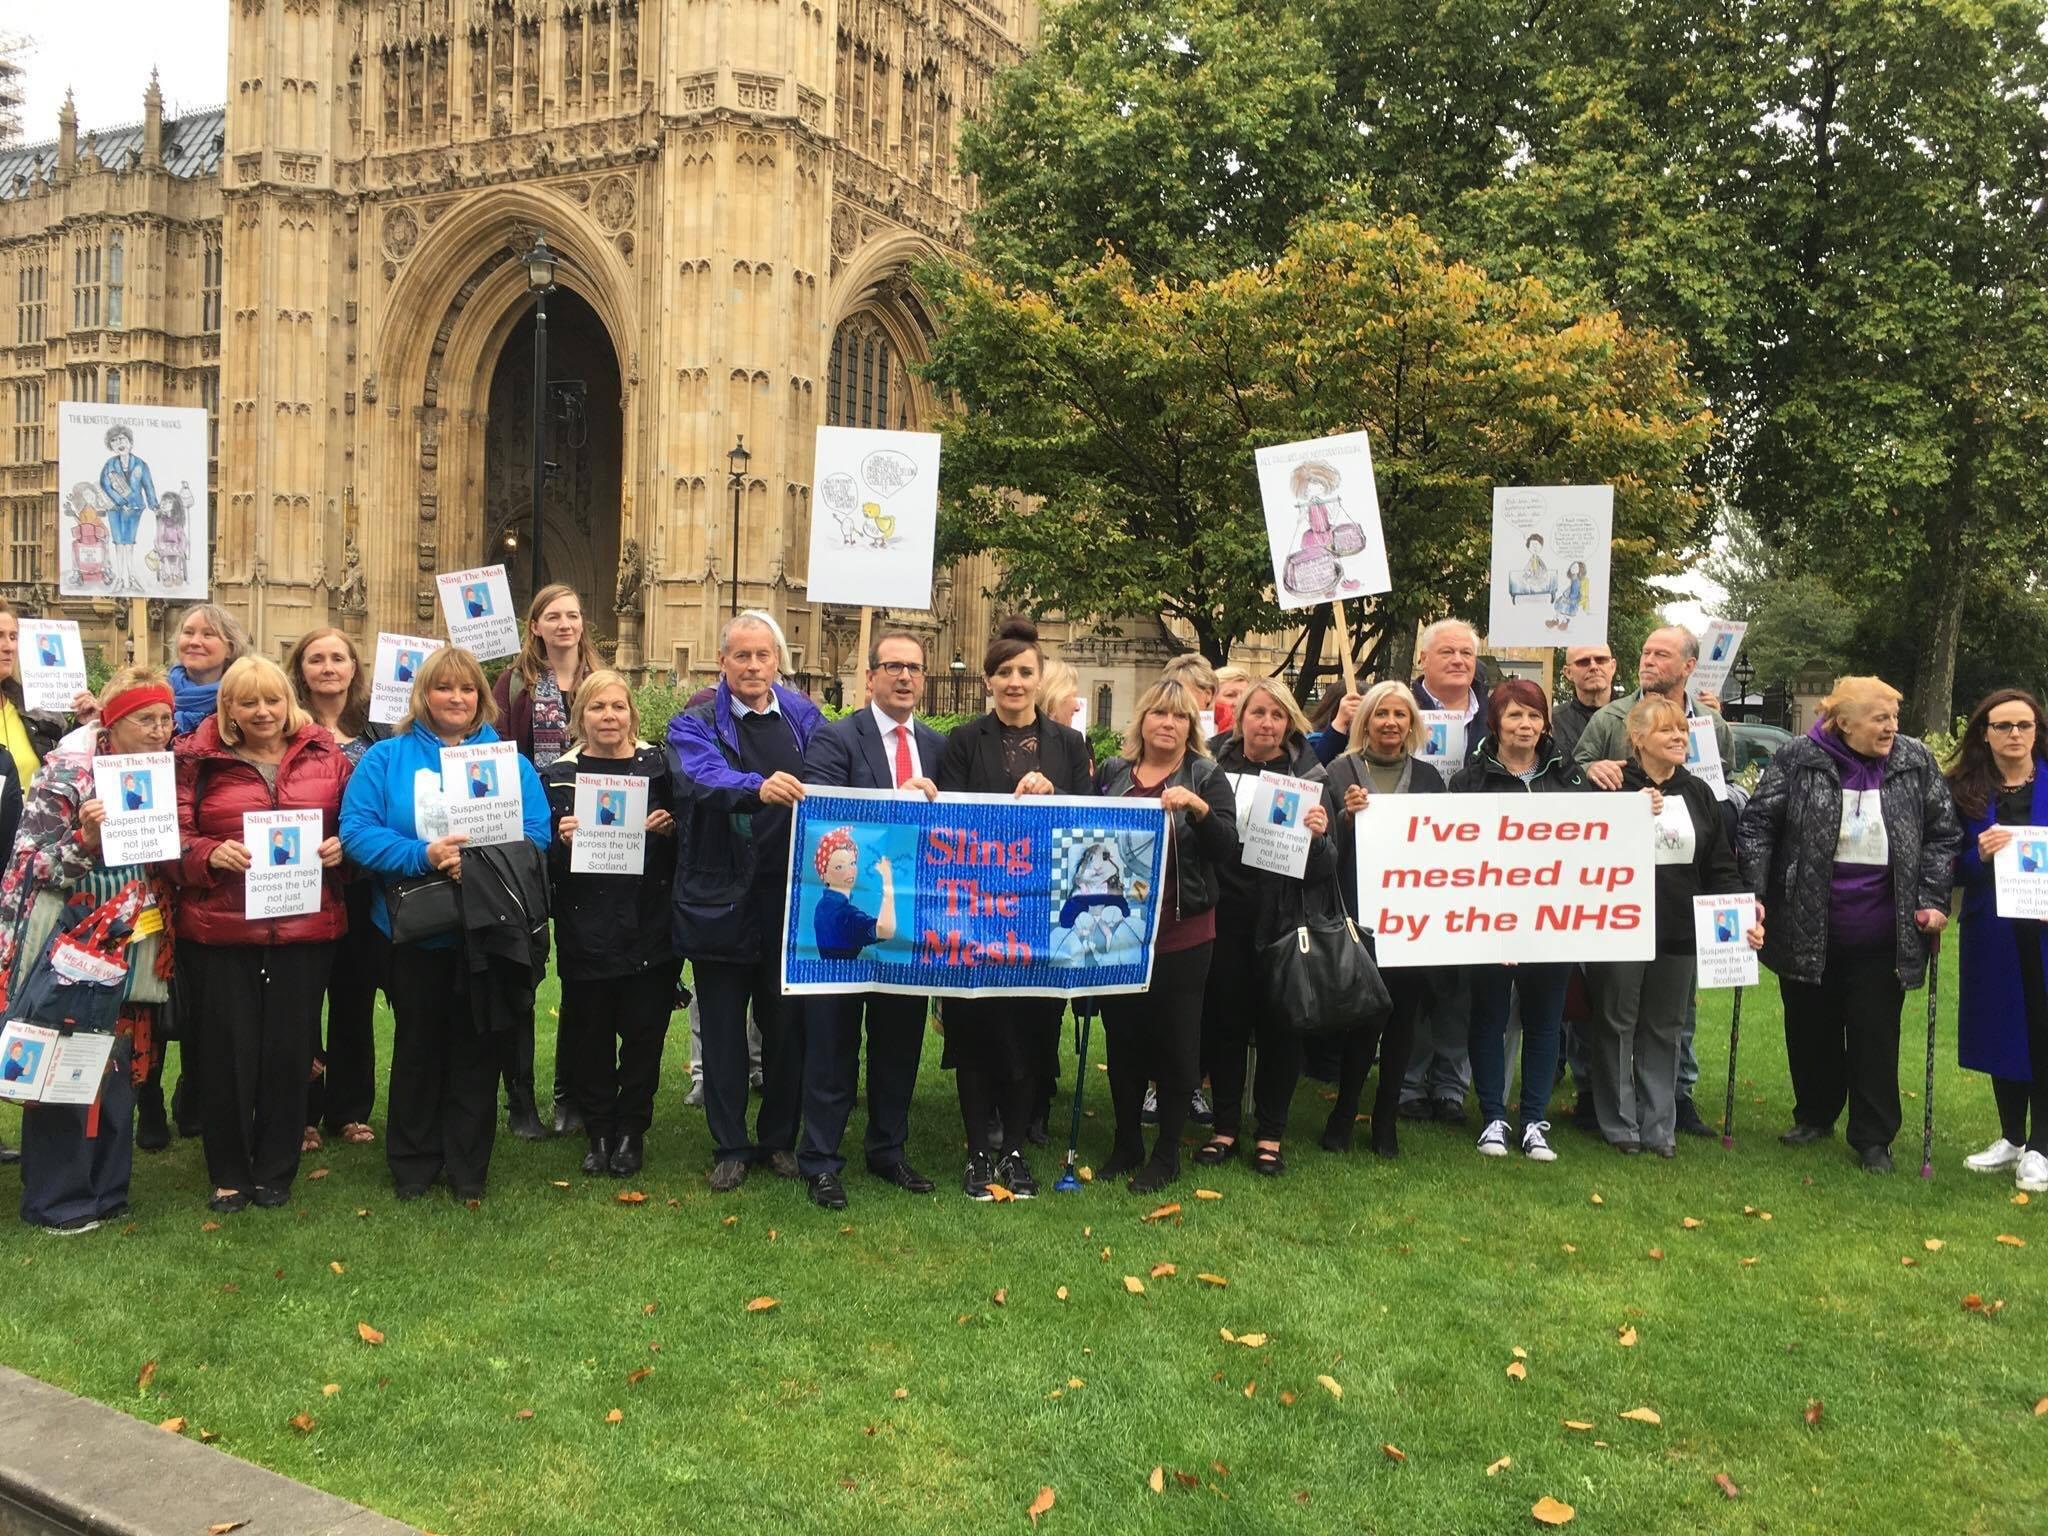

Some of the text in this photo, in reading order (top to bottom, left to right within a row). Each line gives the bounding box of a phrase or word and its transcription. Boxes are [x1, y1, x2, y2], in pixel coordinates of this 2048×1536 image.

[440, 568, 504, 585] Sling The Mesh
[451, 616, 514, 633] Suspend mesh
[455, 626, 513, 644] across the UK
[404, 639, 417, 647] The
[472, 639, 502, 651] not just
[474, 648, 506, 660] cotland
[24, 671, 84, 681] Suspend mesh
[56, 681, 68, 689] the
[70, 681, 84, 689] UK
[42, 691, 71, 700] not just
[376, 694, 403, 703] across
[40, 701, 70, 709] Scotlan
[388, 704, 402, 712] not
[1690, 719, 1711, 728] Mesh
[444, 745, 515, 760] Sling The Mesh
[97, 756, 171, 769] Sling The Mesh
[1698, 764, 1720, 773] mesh
[579, 776, 646, 788] Sling The Mesh
[1706, 774, 1720, 782] UK
[1282, 777, 1297, 788] The
[1299, 781, 1320, 793] Mesh
[450, 799, 520, 815] Suspend mesh
[104, 812, 175, 827] Suspend mesh
[247, 812, 320, 824] Sling The Mesh
[453, 809, 519, 826] across the UK
[106, 824, 174, 839] across the UK
[469, 823, 504, 835] not just
[576, 828, 643, 840] Suspend mesh
[1250, 823, 1309, 845] Suspend mesh
[1407, 815, 1609, 842] I've been
[123, 838, 158, 849] not just
[467, 832, 508, 845] Scotland
[576, 840, 640, 850] across the UK
[1249, 836, 1304, 854] across the UK
[121, 850, 163, 862] Scotland
[592, 851, 625, 861] not just
[926, 827, 1033, 876] Sling
[1260, 848, 1289, 861] not just
[588, 861, 627, 871] Scotland
[1256, 857, 1290, 873] Scotland
[249, 868, 320, 881] Suspend mesh
[1381, 860, 1635, 892] meshed up
[251, 879, 317, 893] across the UK
[2000, 876, 2041, 886] Suspend
[267, 892, 301, 903] not just
[2002, 887, 2033, 896] across
[936, 879, 1020, 917] The
[2017, 897, 2032, 905] not
[264, 903, 304, 915] Scotland
[1377, 904, 1642, 942] by the NHS
[920, 929, 1032, 967] Mesh
[1700, 946, 1734, 956] Suspend
[1702, 958, 1727, 966] across
[1729, 956, 1741, 964] the
[1714, 966, 1742, 975] not just
[1713, 976, 1745, 986] Scotland
